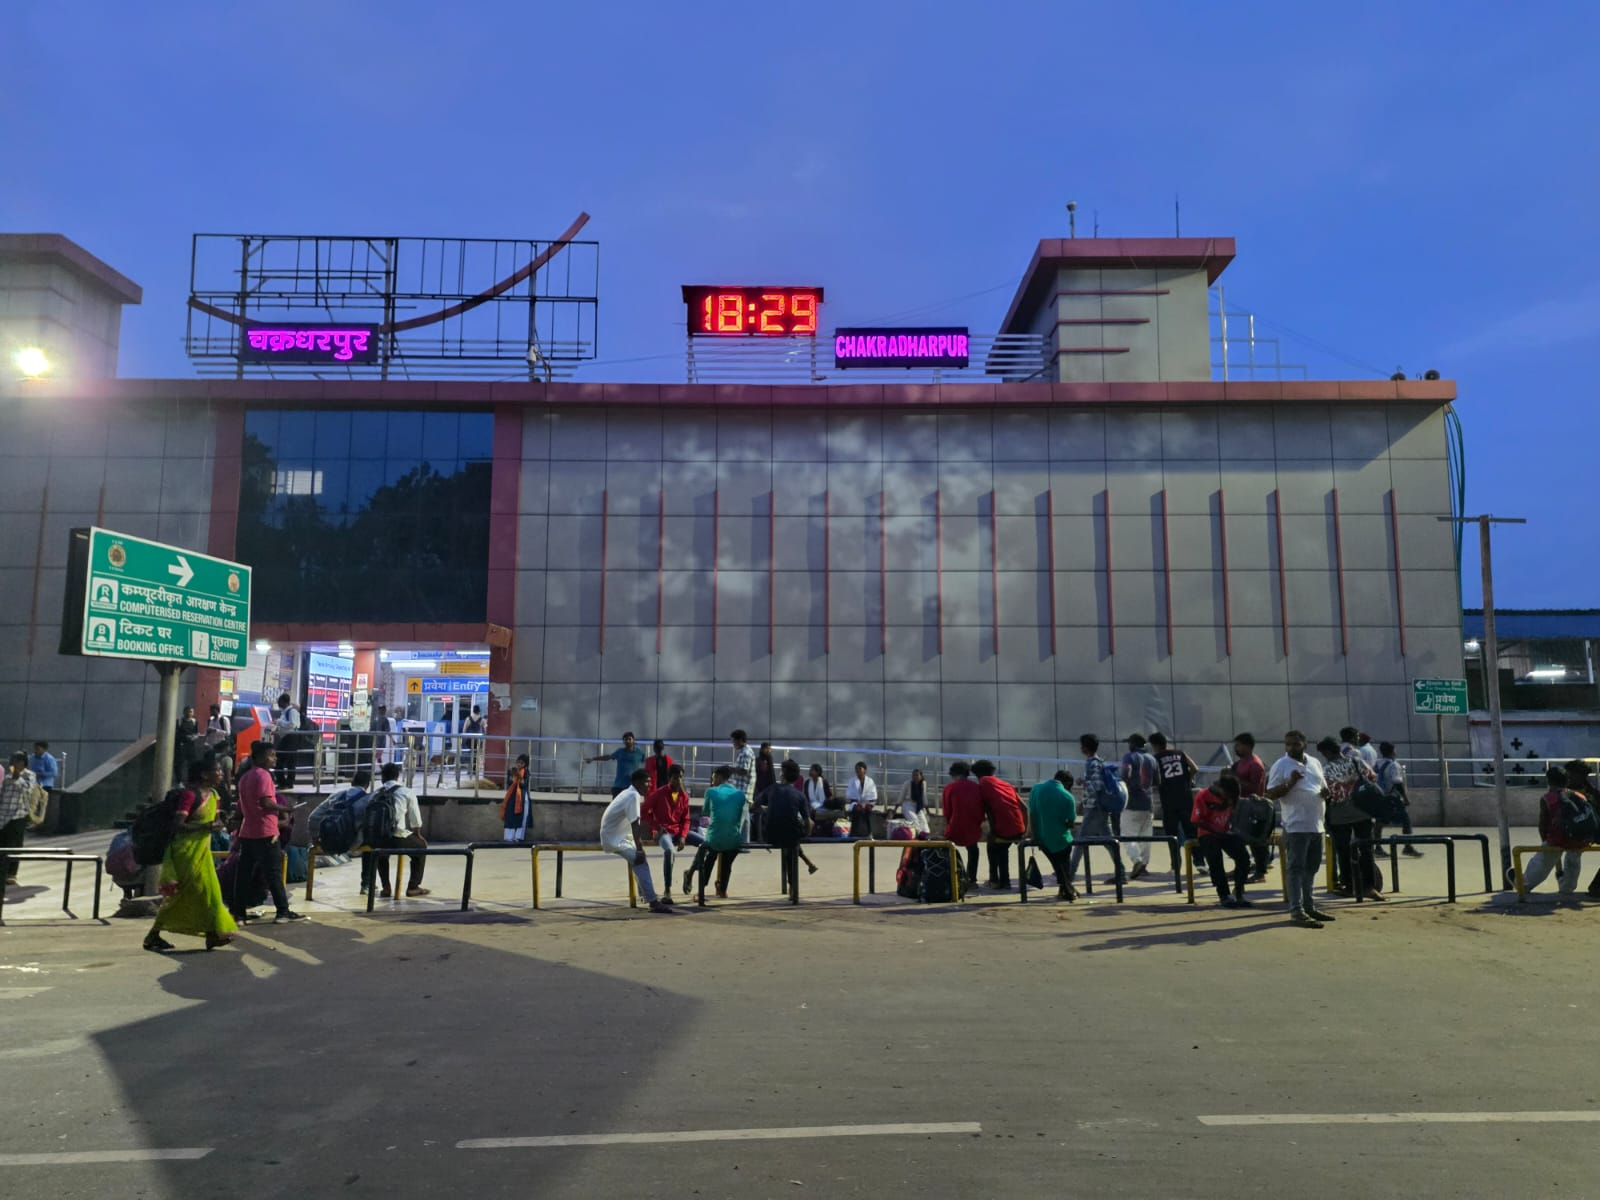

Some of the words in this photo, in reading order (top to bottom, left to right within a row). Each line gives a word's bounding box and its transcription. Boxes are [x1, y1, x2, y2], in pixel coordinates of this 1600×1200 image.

[705, 294, 815, 332] 18:29
[248, 330, 371, 360] चक्रधरपुर
[835, 334, 968, 358] CHAKRADHARPUR
[186, 595, 217, 612] आरक्षण
[219, 599, 237, 616] केन्द्र
[120, 600, 181, 620] COMPUTERISED
[182, 609, 223, 627] RESERVATION
[224, 617, 247, 631] CENTRE
[119, 618, 153, 636] टिकट
[158, 626, 172, 639] घर
[117, 639, 157, 654] BOOKING
[158, 643, 184, 657] OFFICE
[211, 634, 239, 651] पूछताछ
[210, 648, 238, 663] ENQUIRY
[452, 681, 480, 692] Entry
[1435, 703, 1460, 714] Ramp
[1163, 761, 1184, 779] 23
